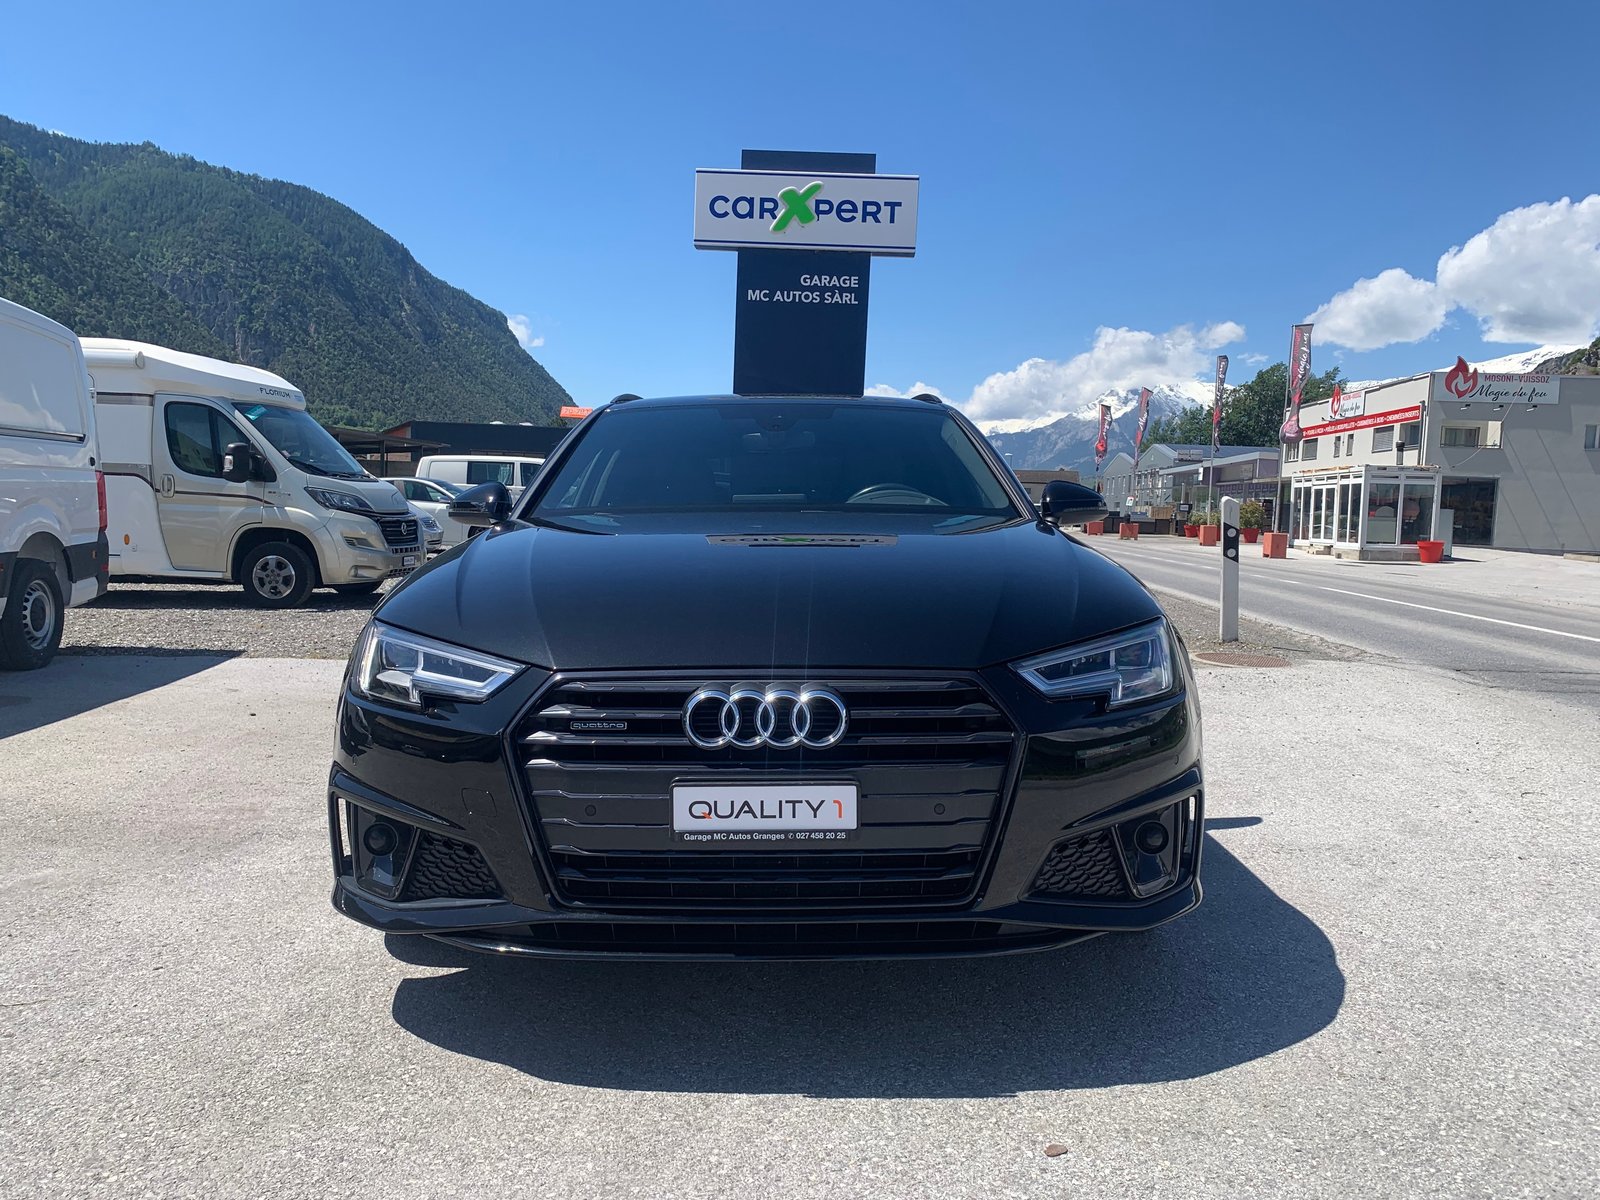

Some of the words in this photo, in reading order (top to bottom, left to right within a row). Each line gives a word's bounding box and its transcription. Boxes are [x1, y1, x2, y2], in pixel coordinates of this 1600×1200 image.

[800, 274, 859, 288] GARAGE
[747, 289, 770, 301] MC
[773, 290, 820, 303] AUTOS
[824, 289, 859, 304] SÀRL
[1484, 375, 1550, 383] MOSONI-VUISSOZ
[259, 387, 291, 398] FLORIUM
[1469, 384, 1511, 401] Magie
[1512, 386, 1527, 397] du
[1527, 387, 1548, 402] feu
[688, 799, 826, 819] QUALITY
[832, 799, 843, 819] 1
[683, 833, 712, 841] Garage
[729, 832, 751, 840] Autos
[753, 832, 785, 841] Granges
